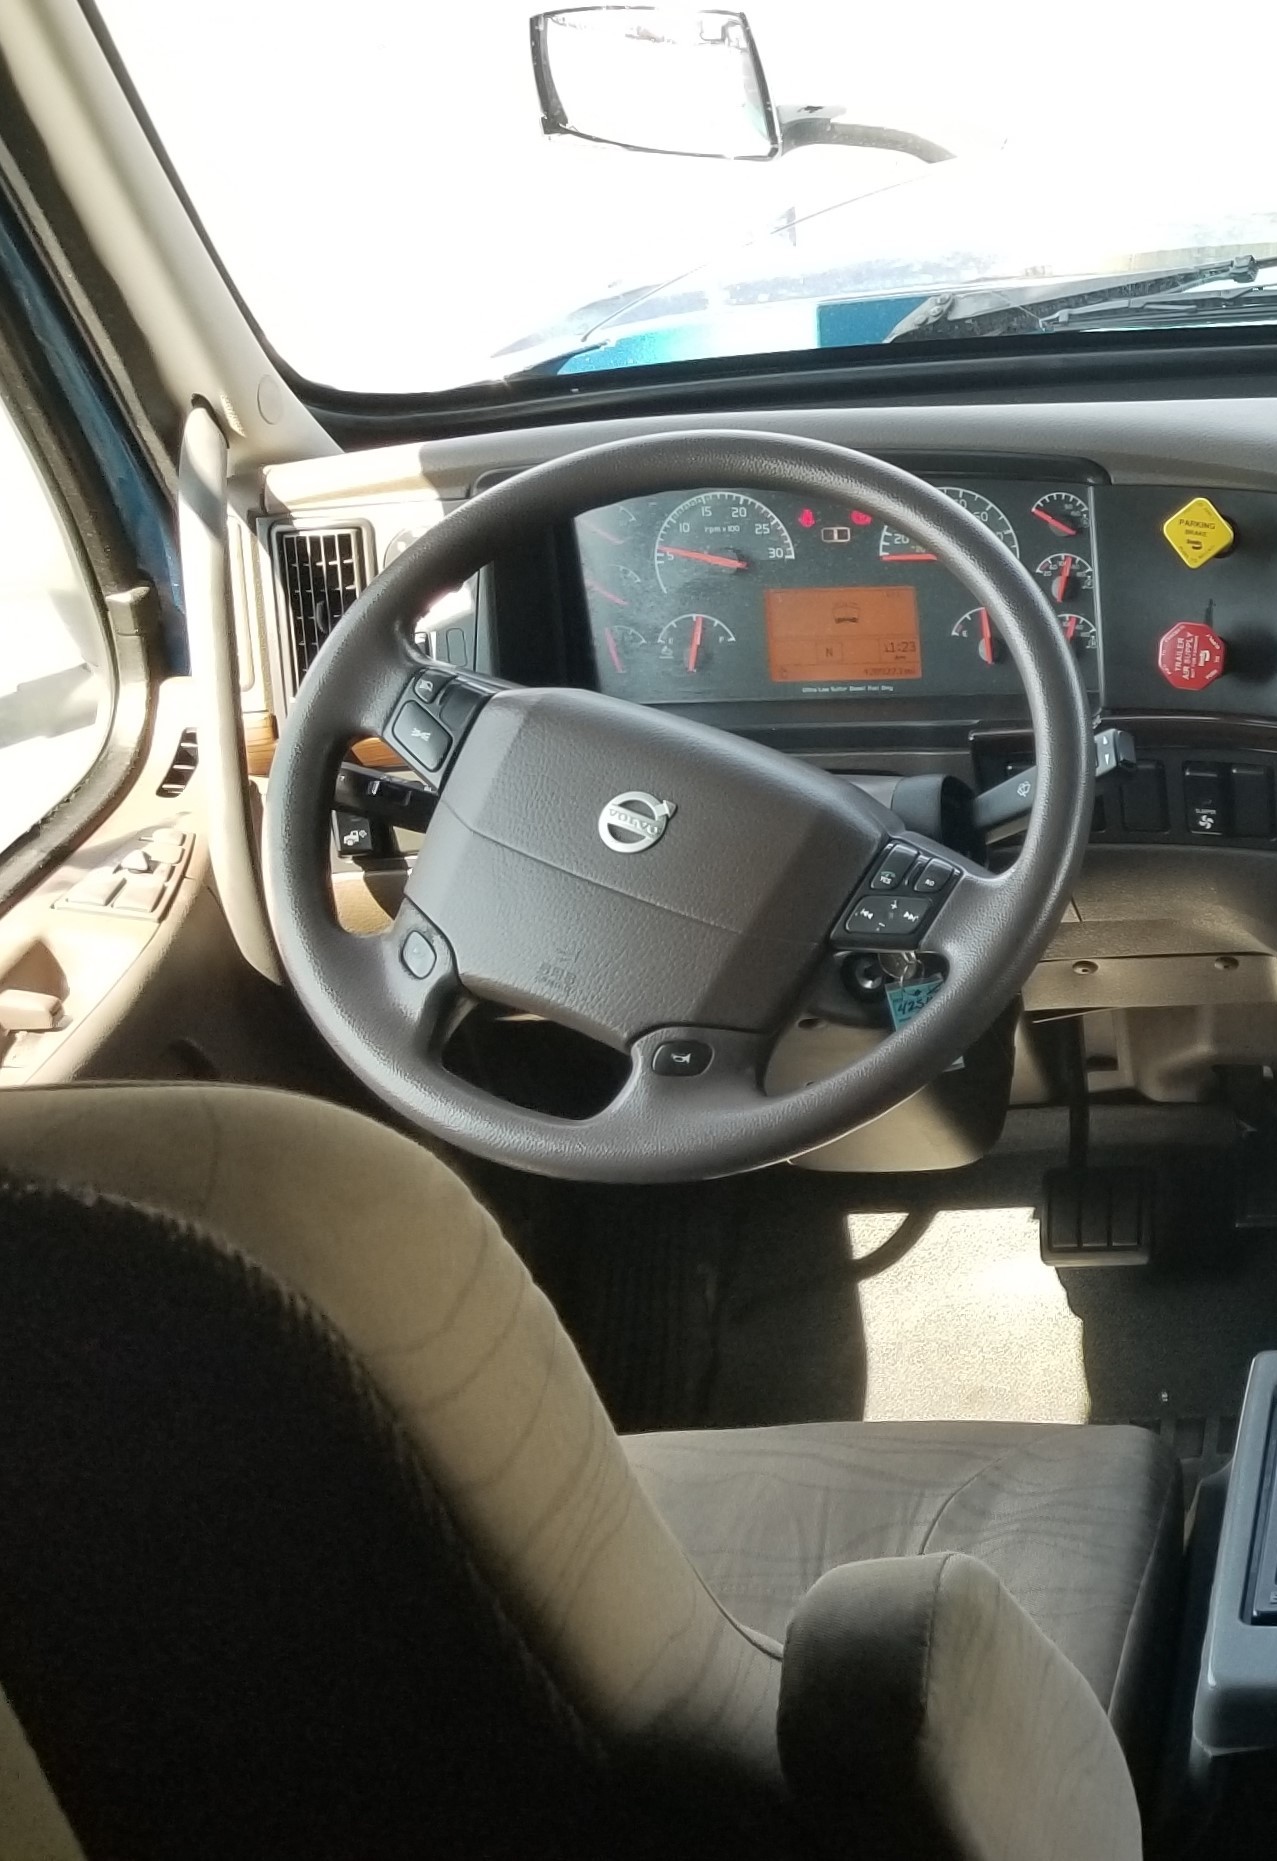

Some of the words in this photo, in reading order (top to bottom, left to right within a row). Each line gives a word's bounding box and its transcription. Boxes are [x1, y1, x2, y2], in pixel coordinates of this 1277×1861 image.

[701, 506, 712, 517] 15
[731, 507, 747, 518] 20
[679, 522, 690, 533] 10
[755, 523, 770, 534] 25
[1179, 518, 1216, 530] PARKING
[704, 526, 721, 534] rpm
[893, 533, 910, 544] 20
[768, 547, 783, 558] 30
[825, 647, 833, 657] N
[1184, 632, 1193, 664] SUPPLY
[1175, 637, 1184, 671] TRAILER
[1182, 666, 1190, 680] AIR
[609, 808, 658, 835] VOLVO
[880, 875, 892, 885] YES
[925, 878, 935, 887] NO
